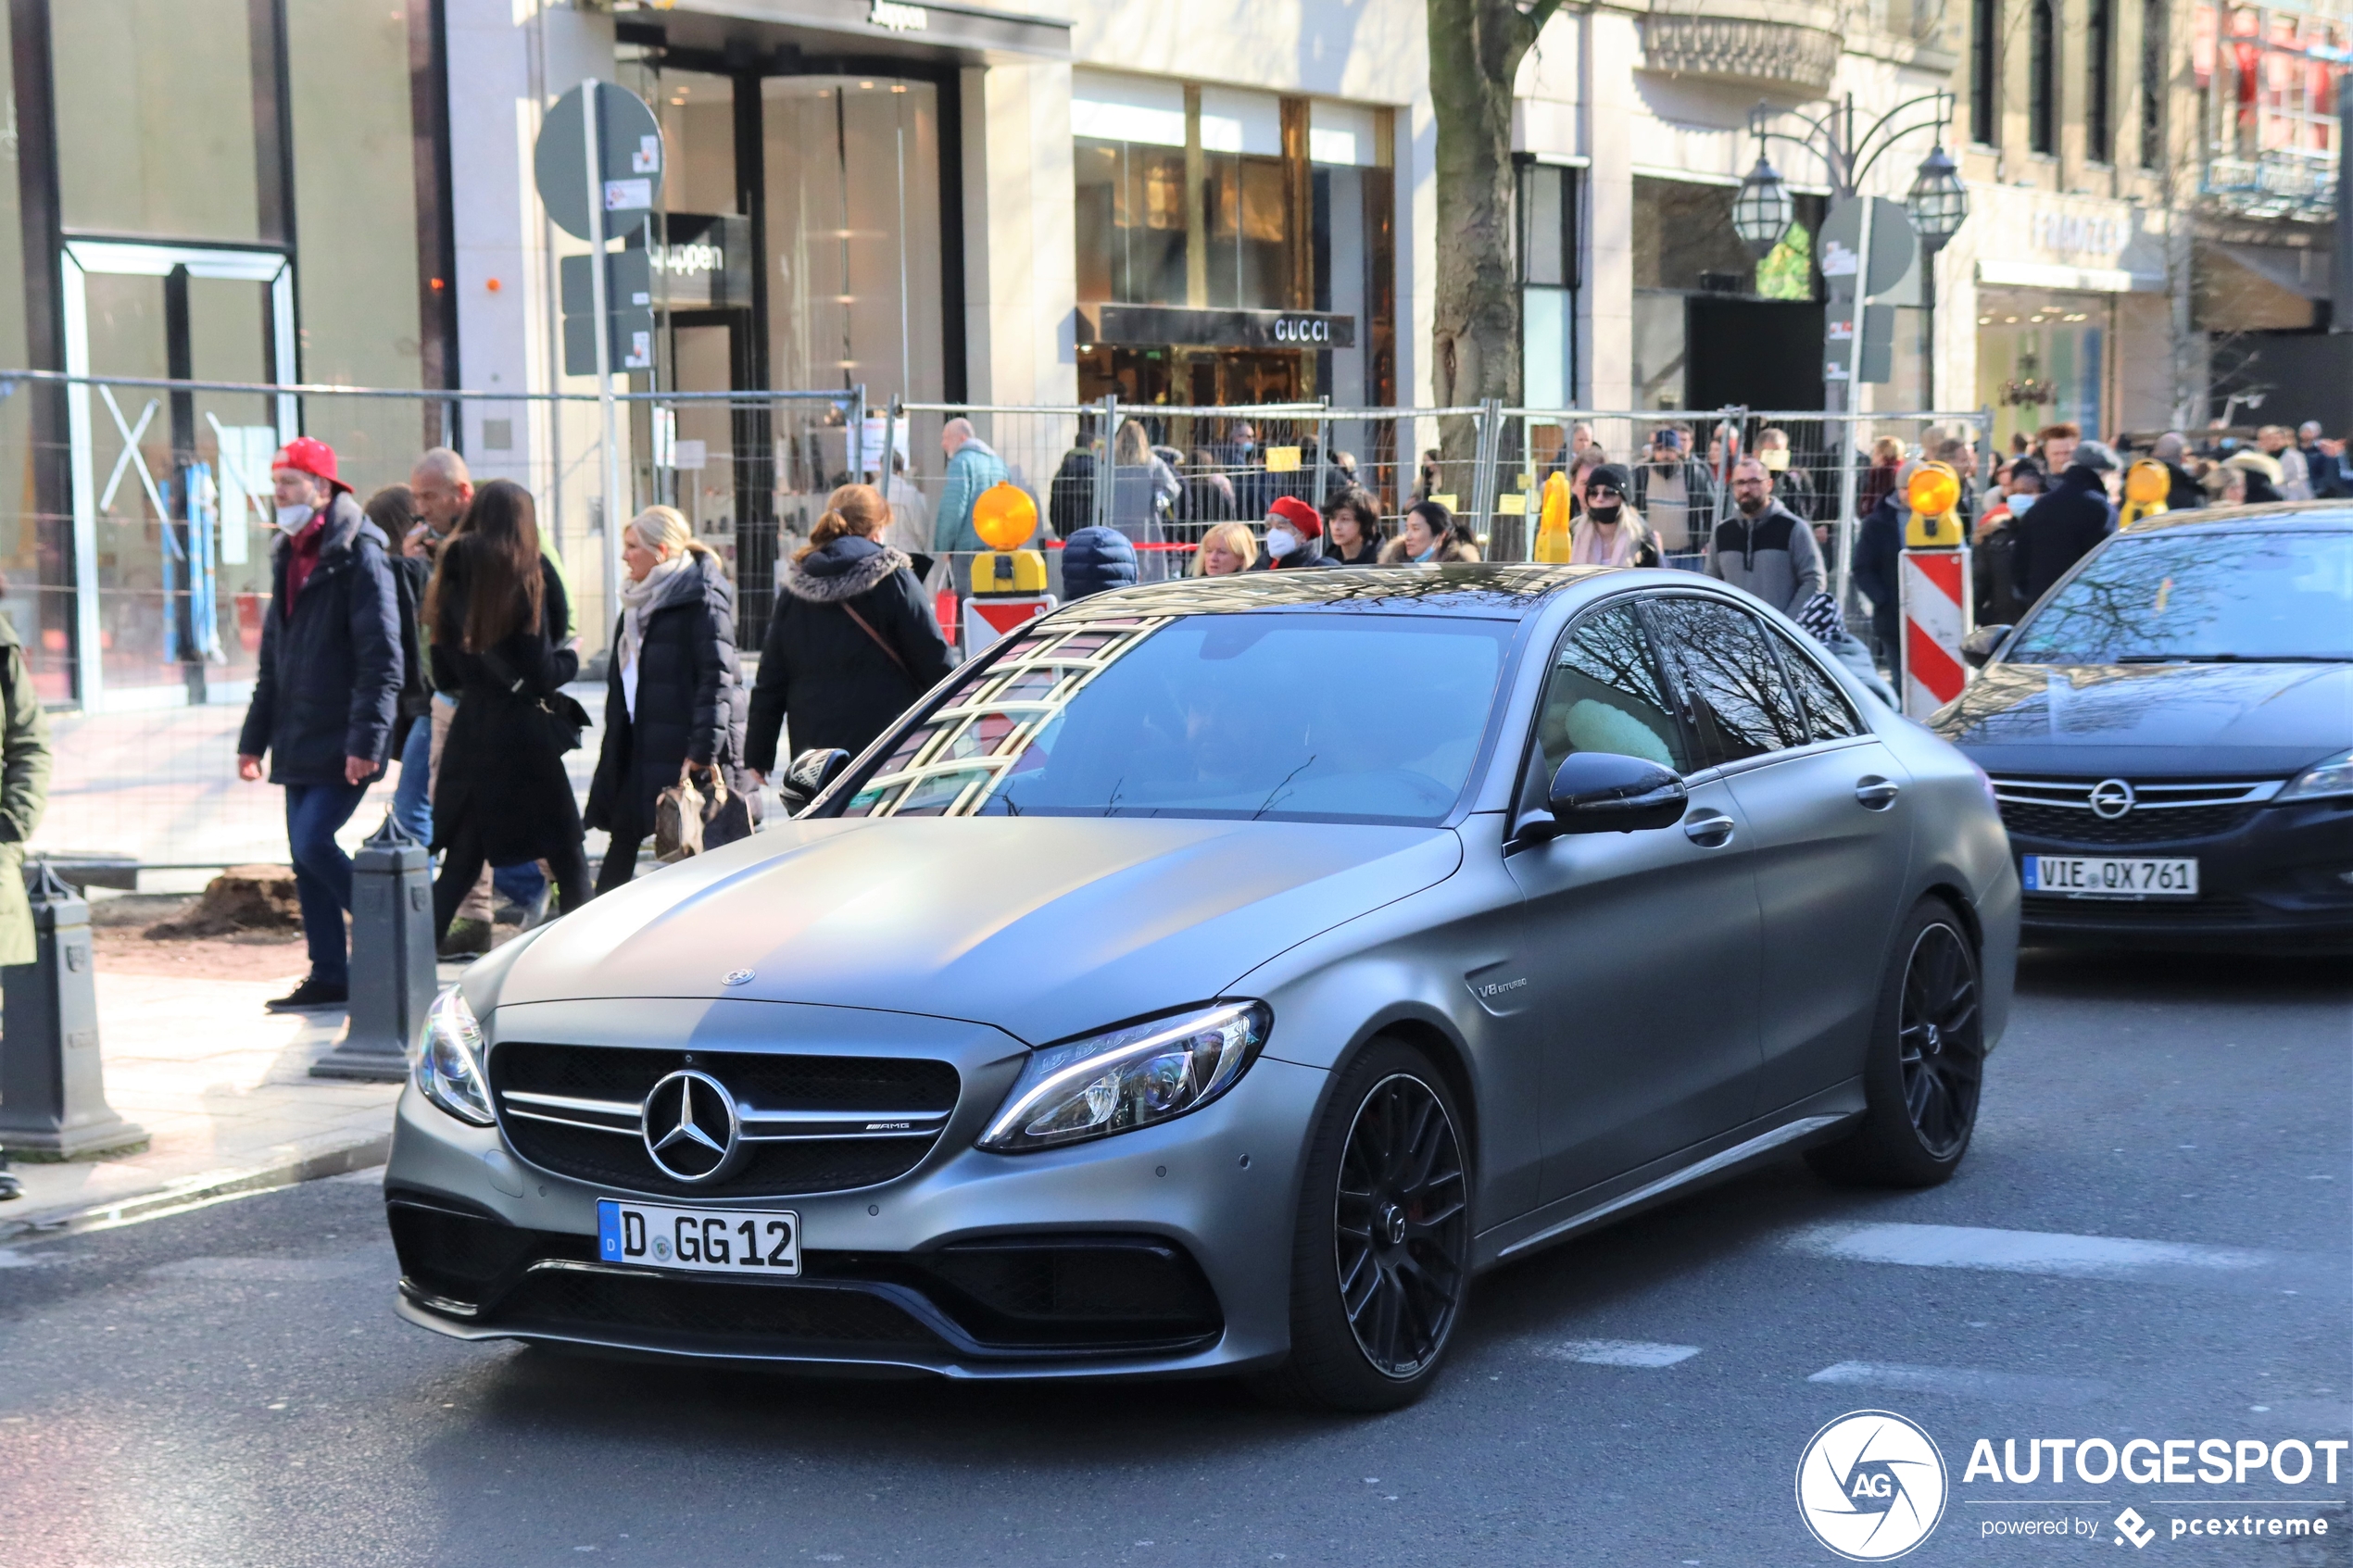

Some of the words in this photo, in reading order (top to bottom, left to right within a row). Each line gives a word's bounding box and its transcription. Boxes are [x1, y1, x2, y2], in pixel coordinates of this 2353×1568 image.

[1275, 319, 1329, 342] GUCCI
[2041, 860, 2084, 887] VIE
[2103, 862, 2134, 888] QX
[2142, 863, 2189, 889] 761
[1478, 984, 1498, 997] V8
[1498, 978, 1528, 993] BITURBO
[607, 1238, 616, 1251] D
[622, 1210, 646, 1257] D
